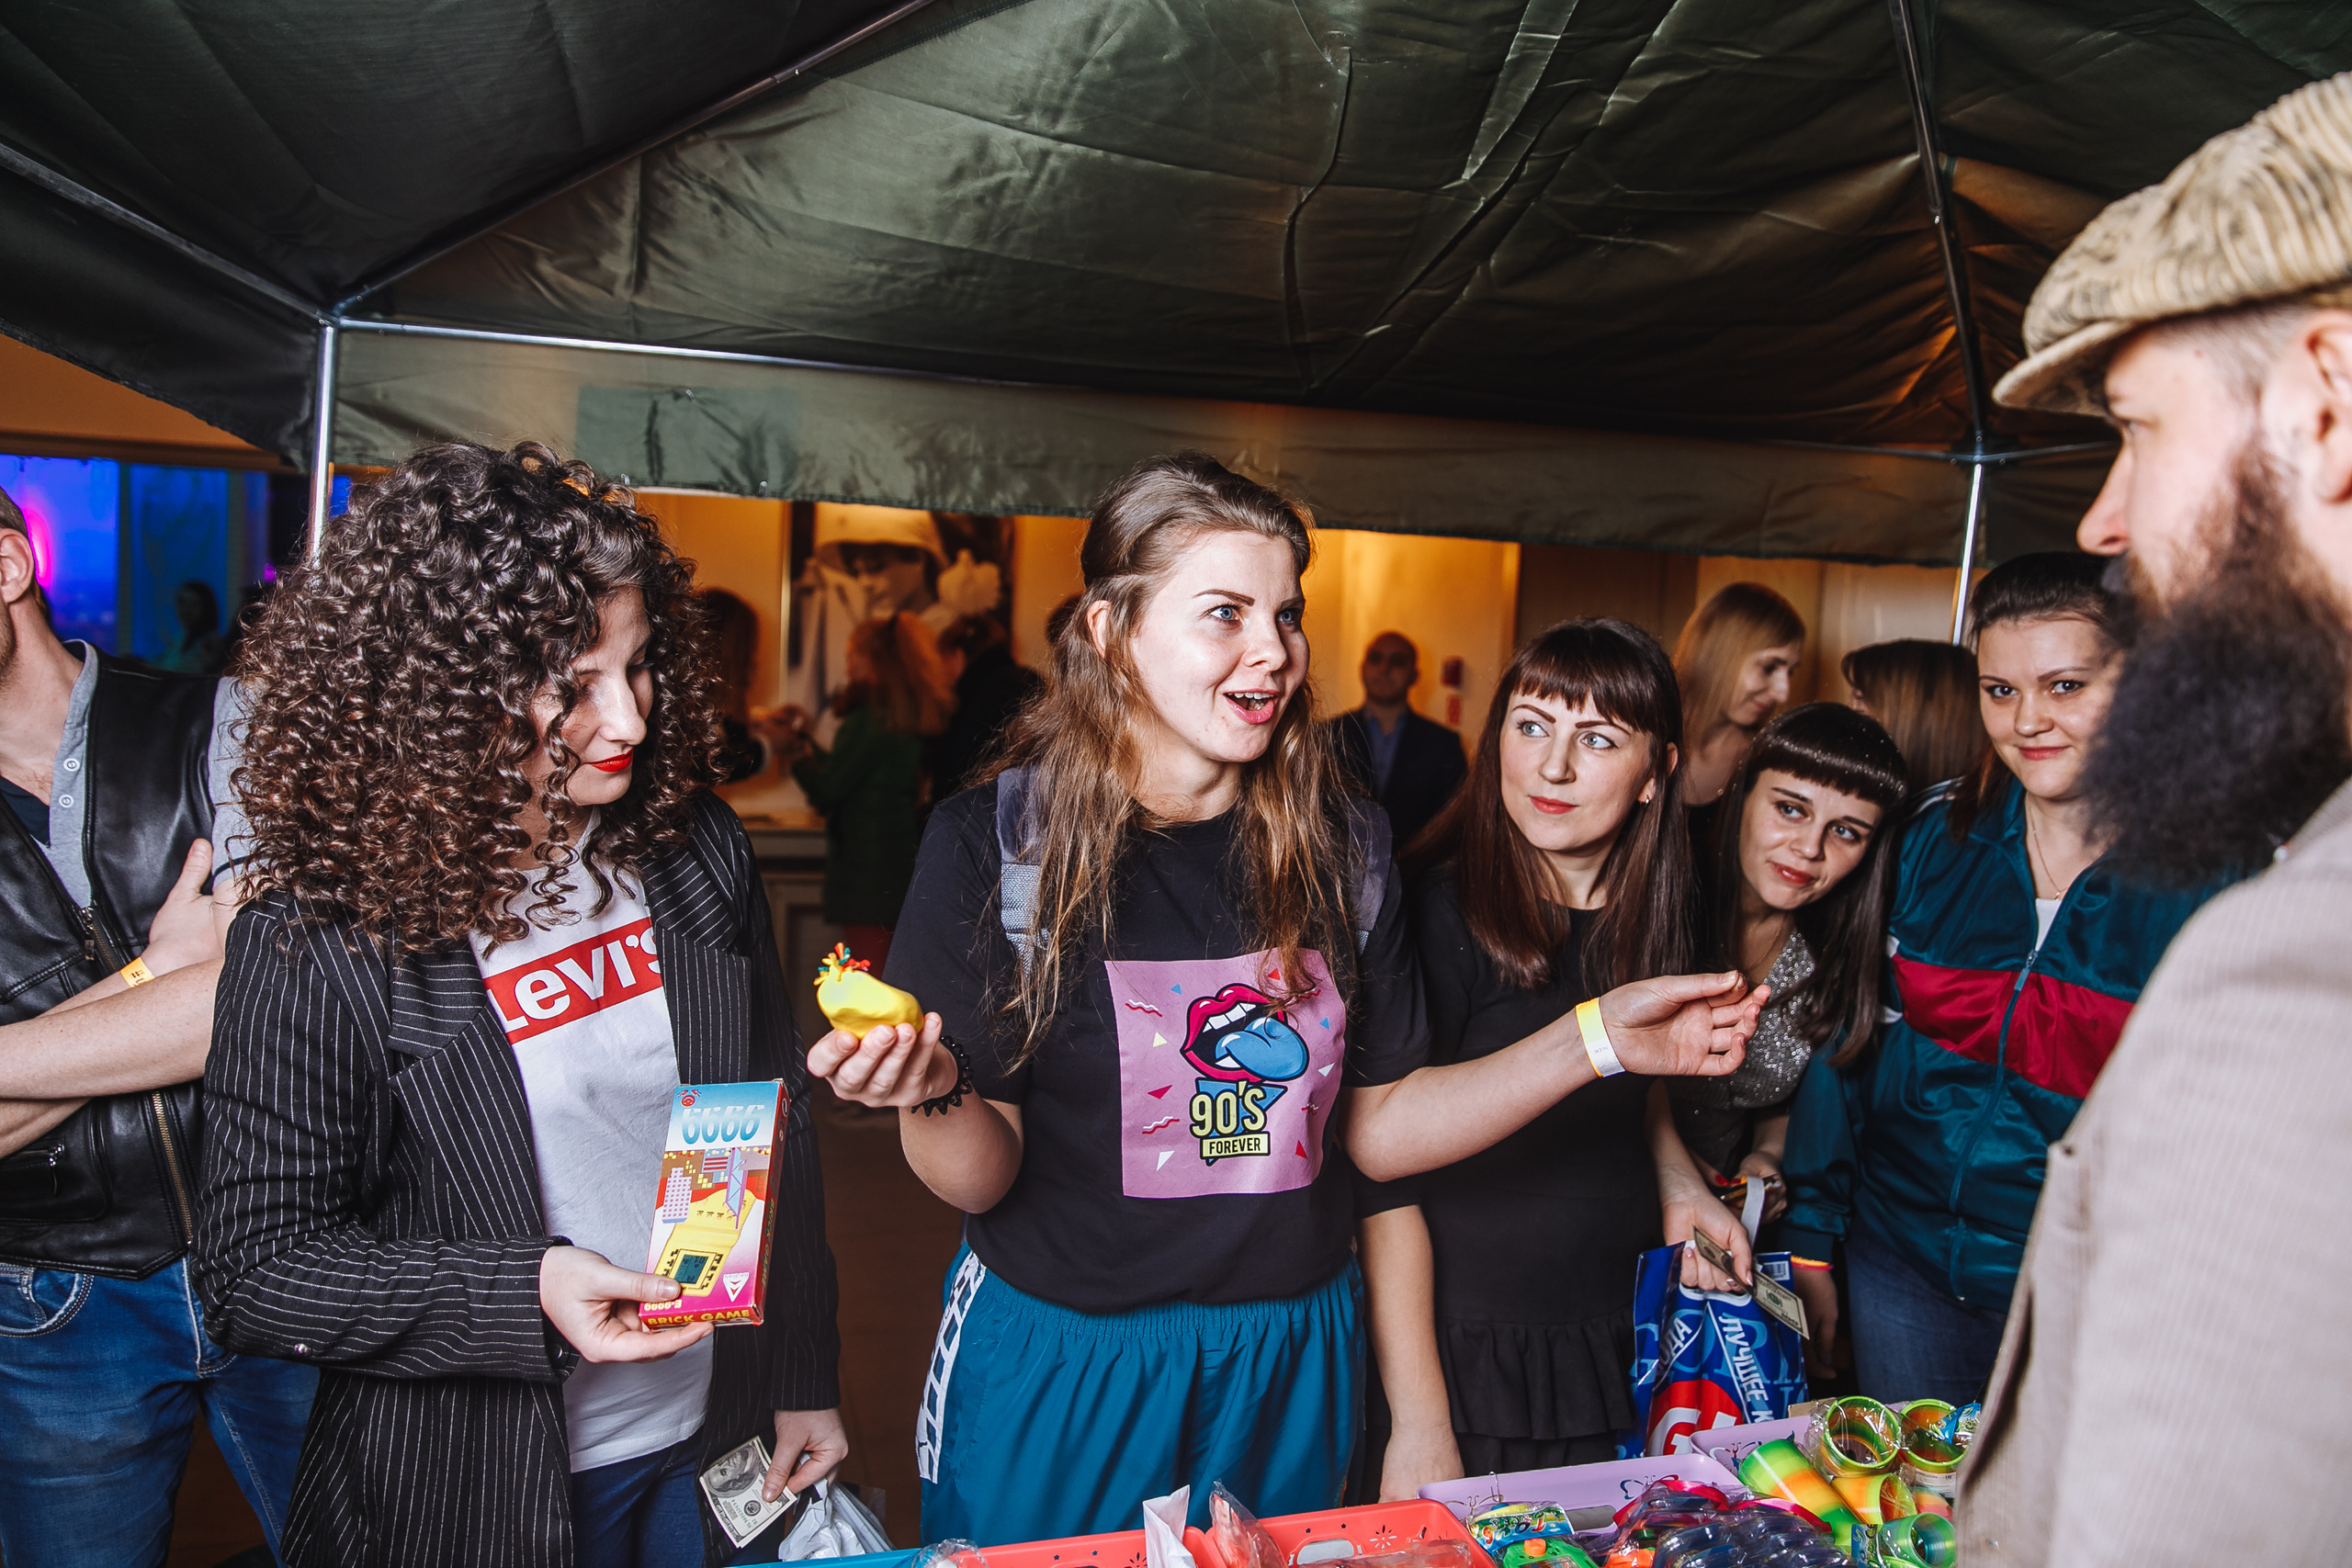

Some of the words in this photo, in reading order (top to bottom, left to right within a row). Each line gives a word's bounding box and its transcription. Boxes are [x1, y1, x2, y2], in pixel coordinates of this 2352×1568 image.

[1209, 1137, 1261, 1155] FOREVER
[647, 1314, 695, 1325] BRICK
[700, 1309, 751, 1322] GAME
[1718, 1314, 1769, 1403] ЛУЧШЕЕ
